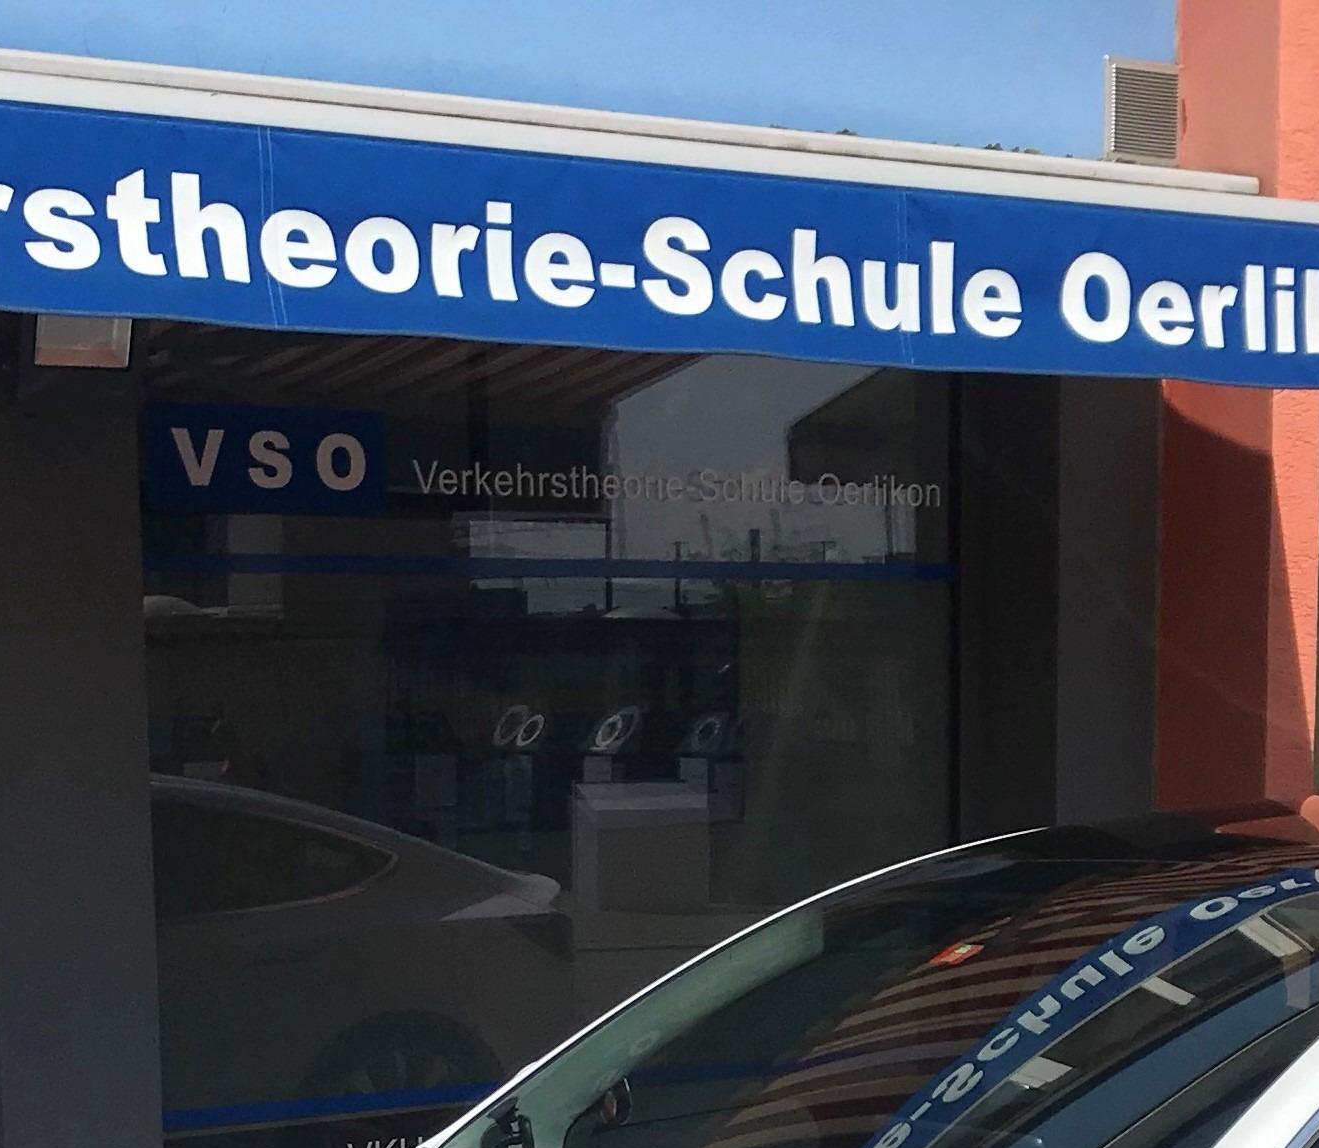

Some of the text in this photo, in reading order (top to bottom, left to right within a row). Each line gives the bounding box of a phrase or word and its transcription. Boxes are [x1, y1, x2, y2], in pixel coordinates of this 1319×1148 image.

[171, 427, 366, 492] VSO
[411, 458, 942, 508] Verkehrstheorie-Schule Oerlikon
